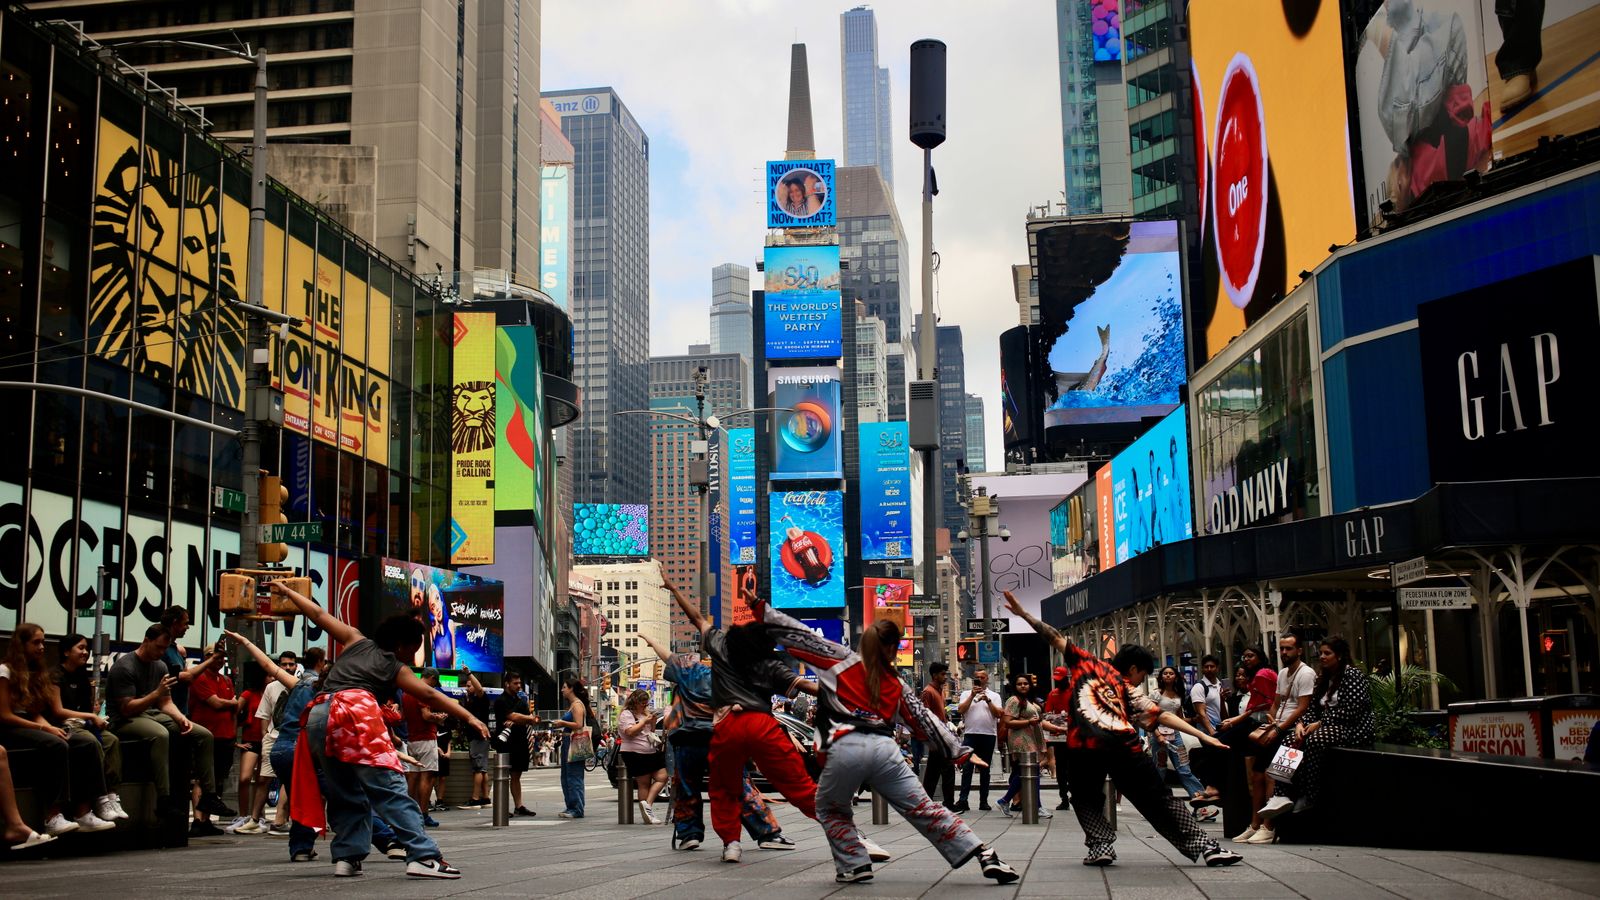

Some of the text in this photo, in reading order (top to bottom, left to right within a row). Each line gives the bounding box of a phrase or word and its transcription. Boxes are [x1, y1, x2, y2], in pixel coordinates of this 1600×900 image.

[771, 164, 793, 174] NOW
[1229, 175, 1248, 217] One
[772, 213, 794, 224] NOW
[541, 181, 560, 289] TIMES
[303, 280, 340, 331] THE
[768, 302, 838, 312] THE WORLD'S
[779, 312, 828, 321] WETTEST
[784, 323, 821, 332] PARTY
[270, 332, 381, 422] ION KING
[777, 375, 830, 384] SAMSUNG
[1457, 332, 1560, 441] GAP
[285, 413, 310, 430] ENTRANCE
[315, 427, 323, 436] ON
[340, 434, 355, 448] STREET
[456, 460, 474, 468] PRIDE
[462, 468, 491, 477] CALLING
[229, 493, 233, 508] 7
[1211, 457, 1289, 534] OLD NAVY
[274, 525, 320, 541] W 44 St
[1345, 516, 1384, 557] GAP
[49, 519, 172, 623] CBS
[1453, 590, 1467, 598] ZONE
[1065, 594, 1075, 617] OLD
[1462, 722, 1525, 740] MAKE IT YOUR
[1569, 728, 1591, 736] BES
[1463, 739, 1526, 757] MISSION
[1276, 756, 1296, 767] NY
[1273, 765, 1292, 774] GIFTS
